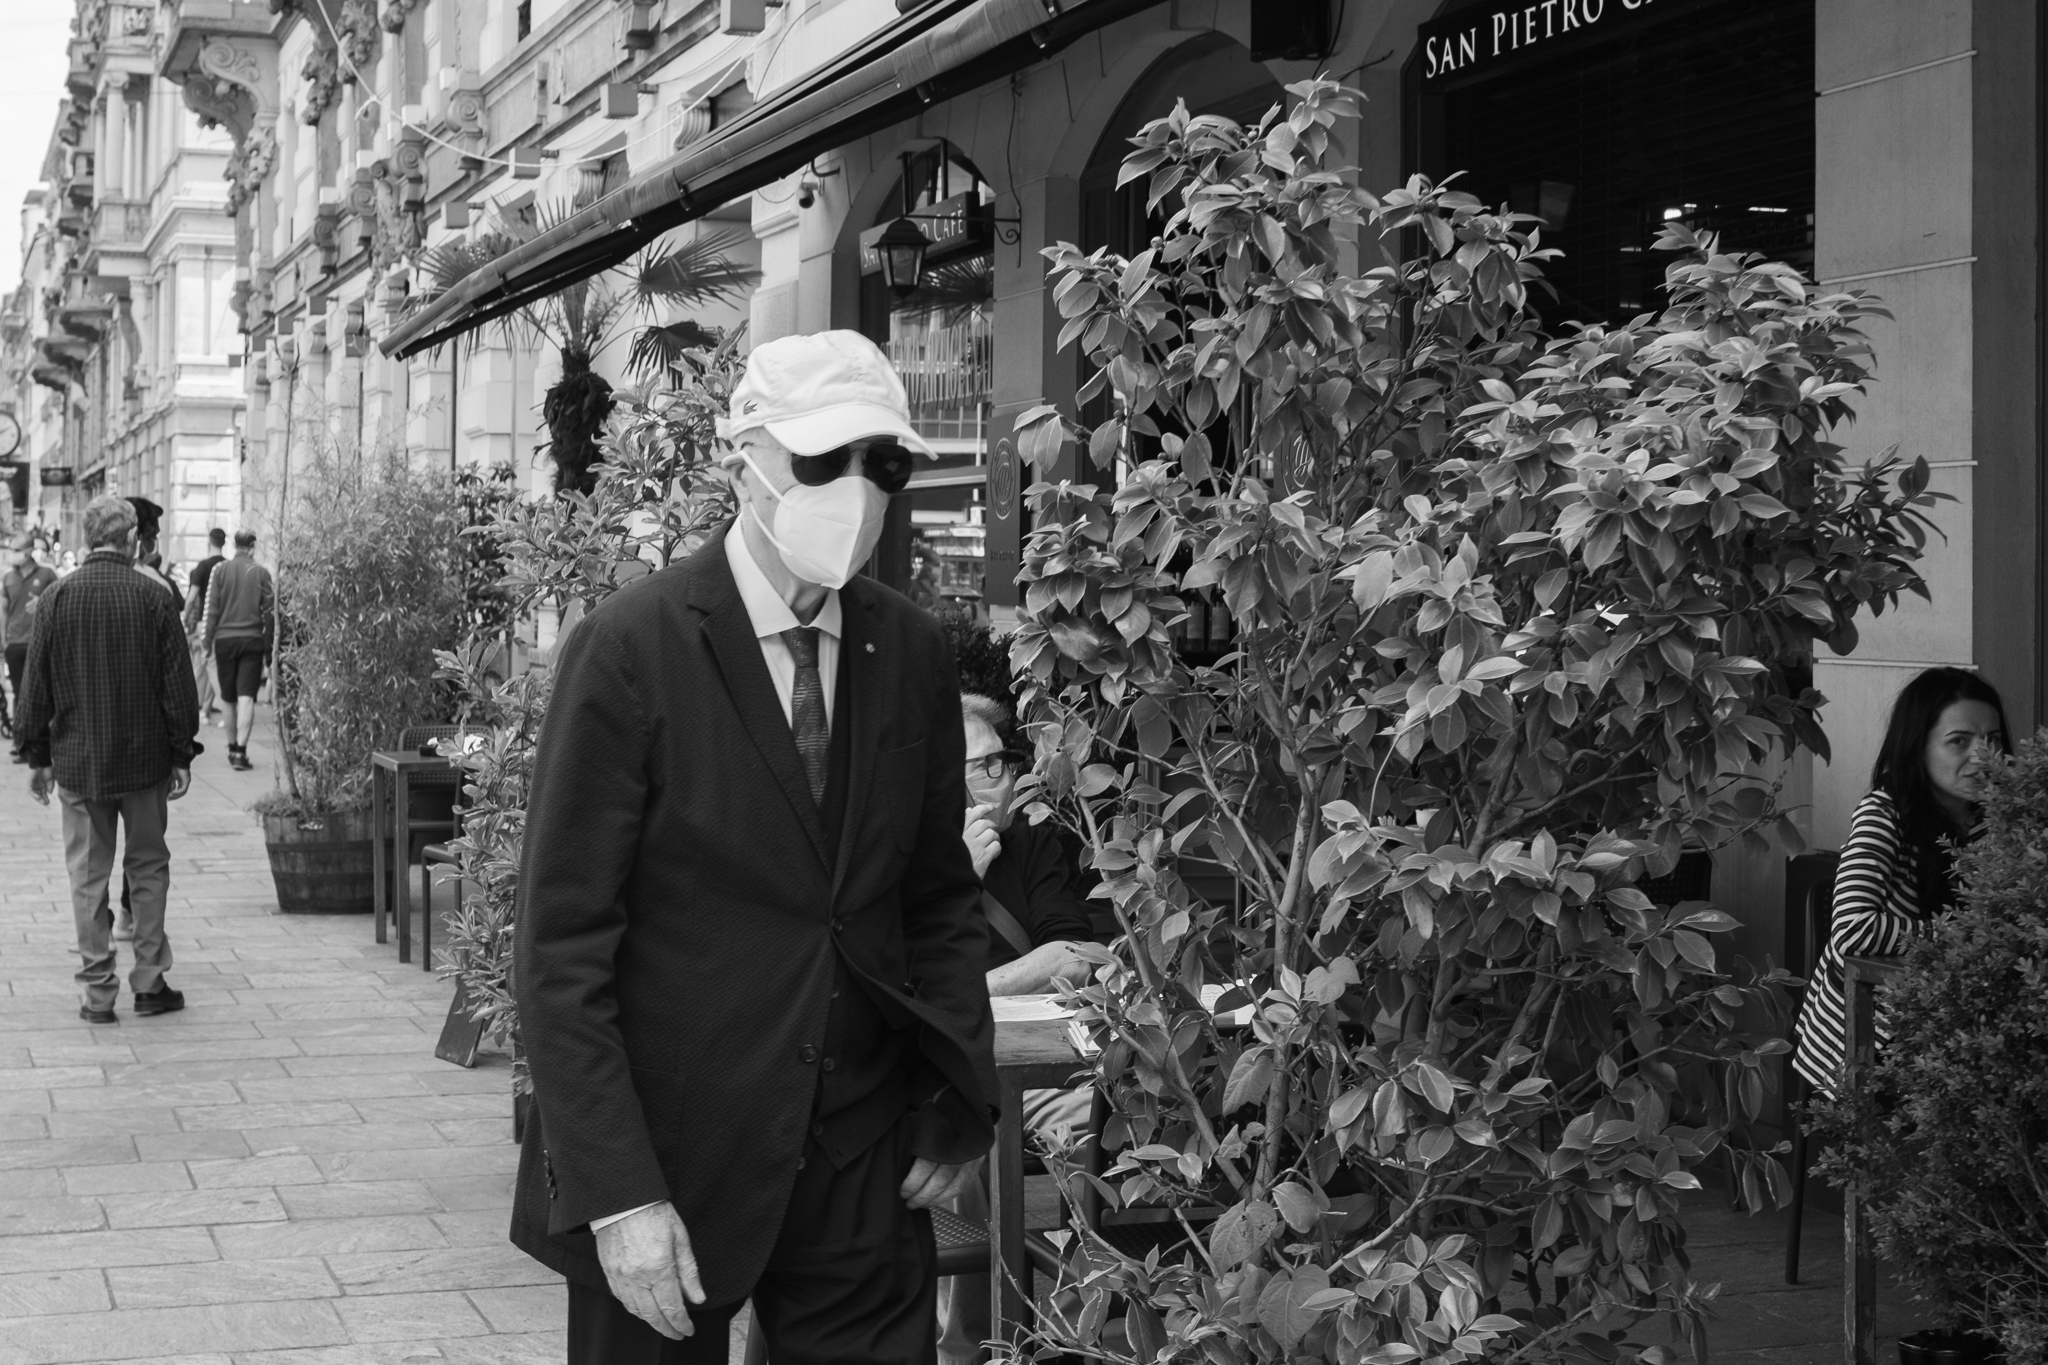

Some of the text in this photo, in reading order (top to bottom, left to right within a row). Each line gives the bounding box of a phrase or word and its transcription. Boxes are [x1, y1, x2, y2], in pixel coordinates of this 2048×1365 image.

[1425, 0, 1604, 79] SAN PIETRO
[933, 203, 964, 242] CAFÈ
